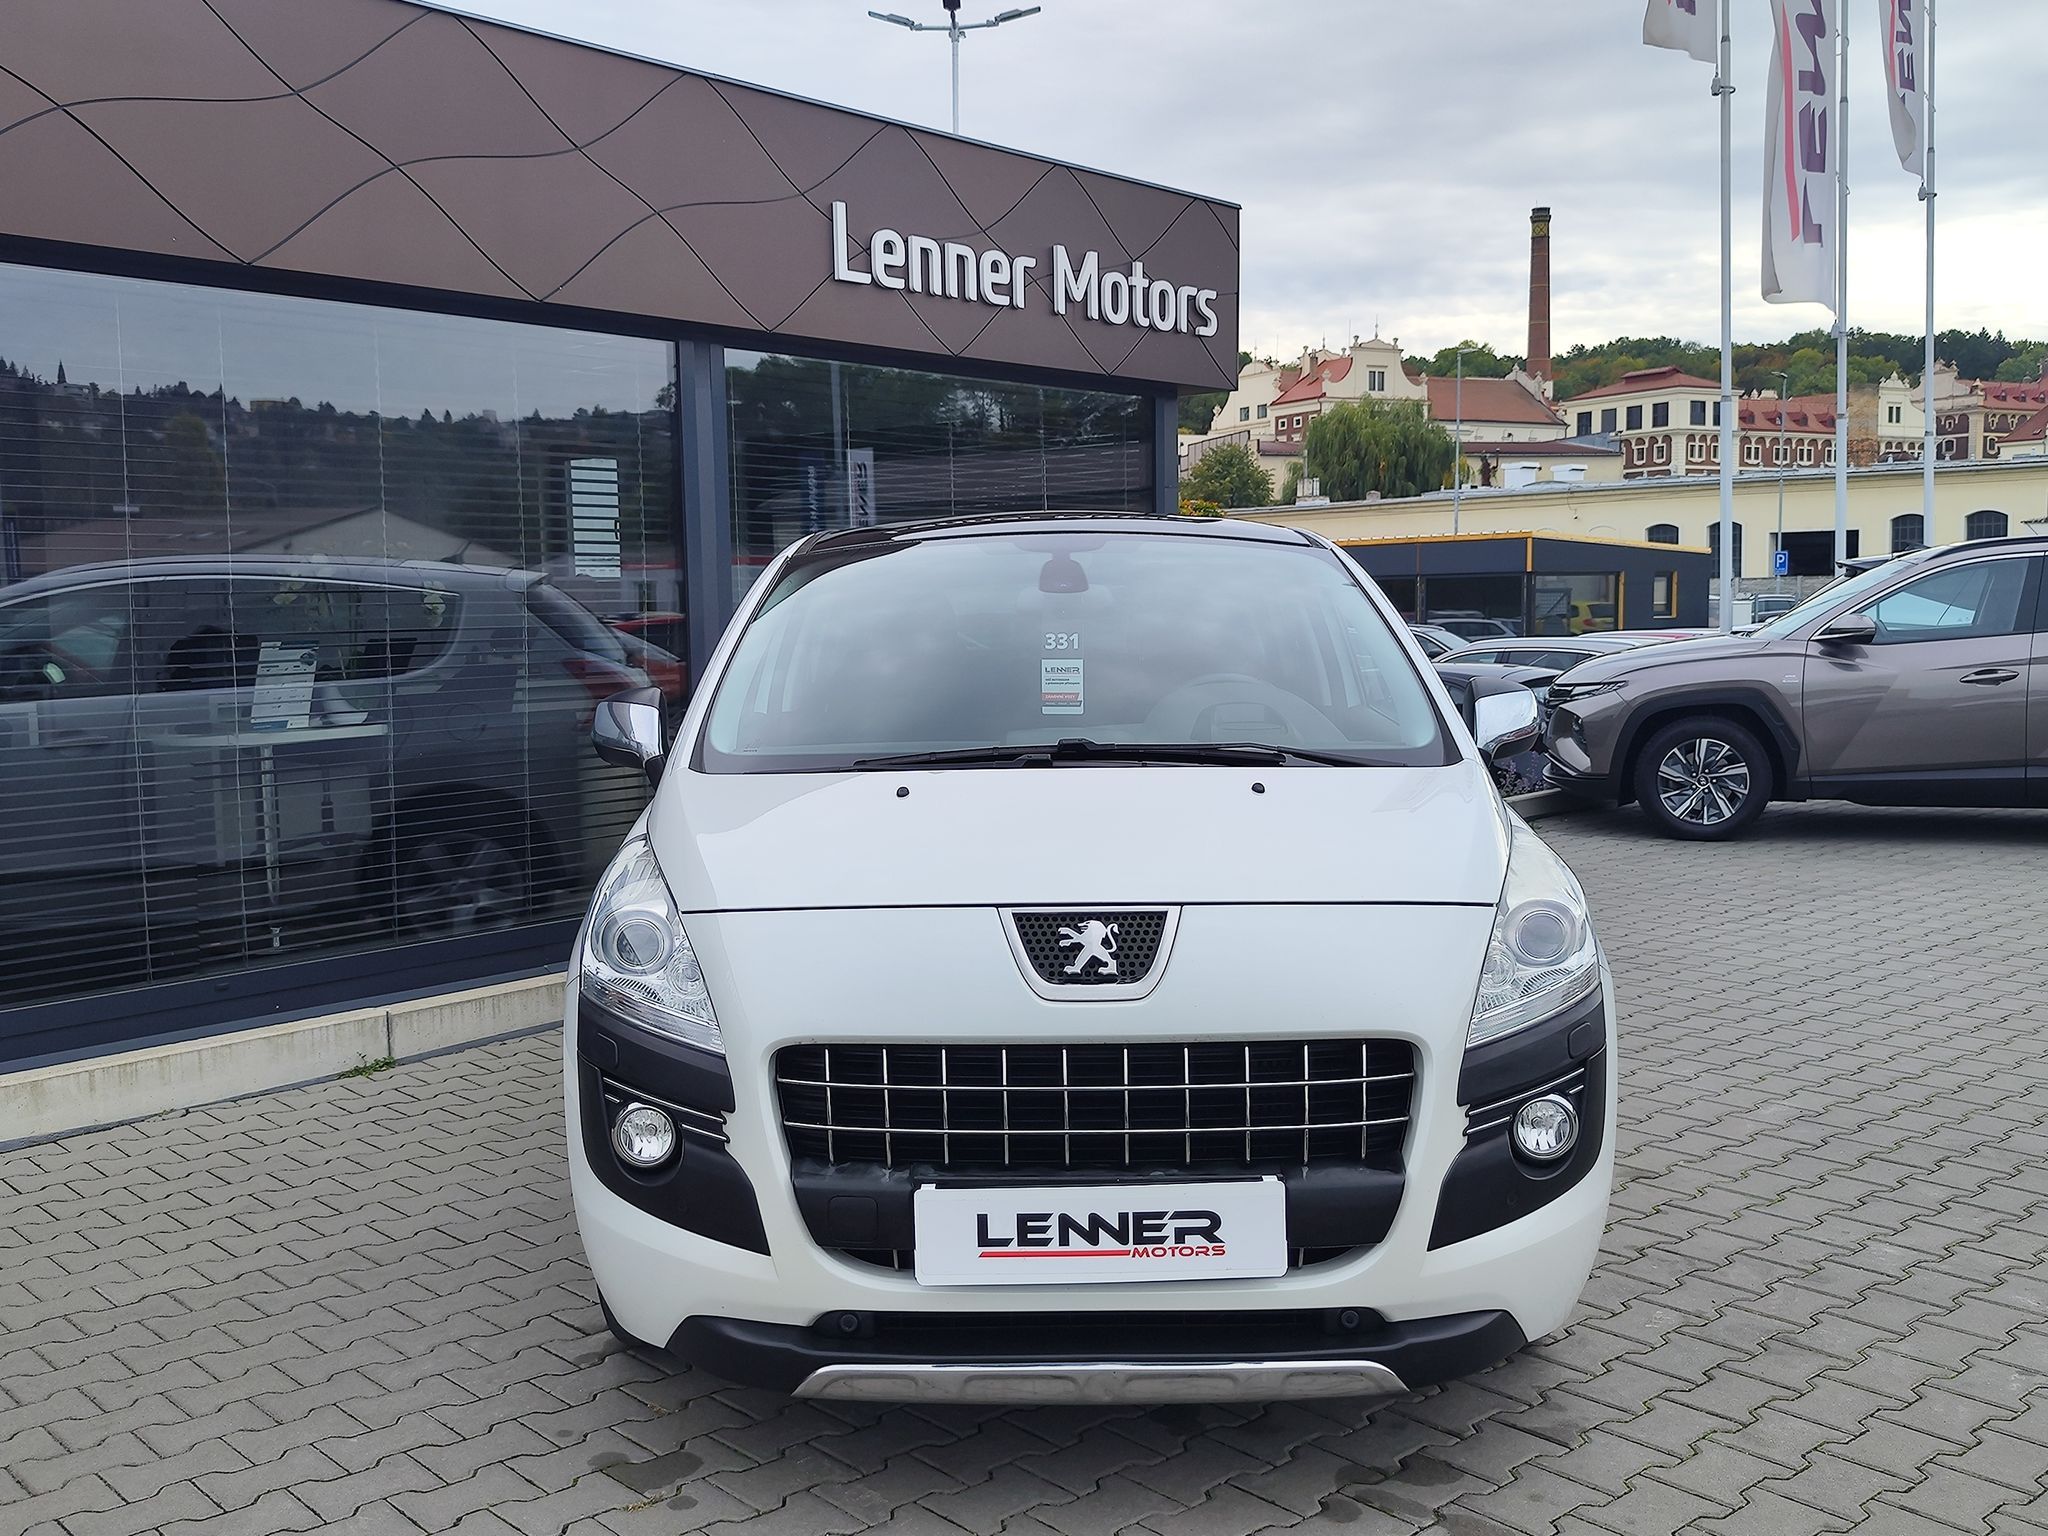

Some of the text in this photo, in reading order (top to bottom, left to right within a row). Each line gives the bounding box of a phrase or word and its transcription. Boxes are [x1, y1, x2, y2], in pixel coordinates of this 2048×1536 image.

[831, 200, 1218, 337] Lenner Motors
[1776, 554, 1785, 567] P
[1044, 632, 1079, 649] 331
[977, 1210, 1224, 1247] LENNER
[1132, 1244, 1225, 1259] MOTORS
